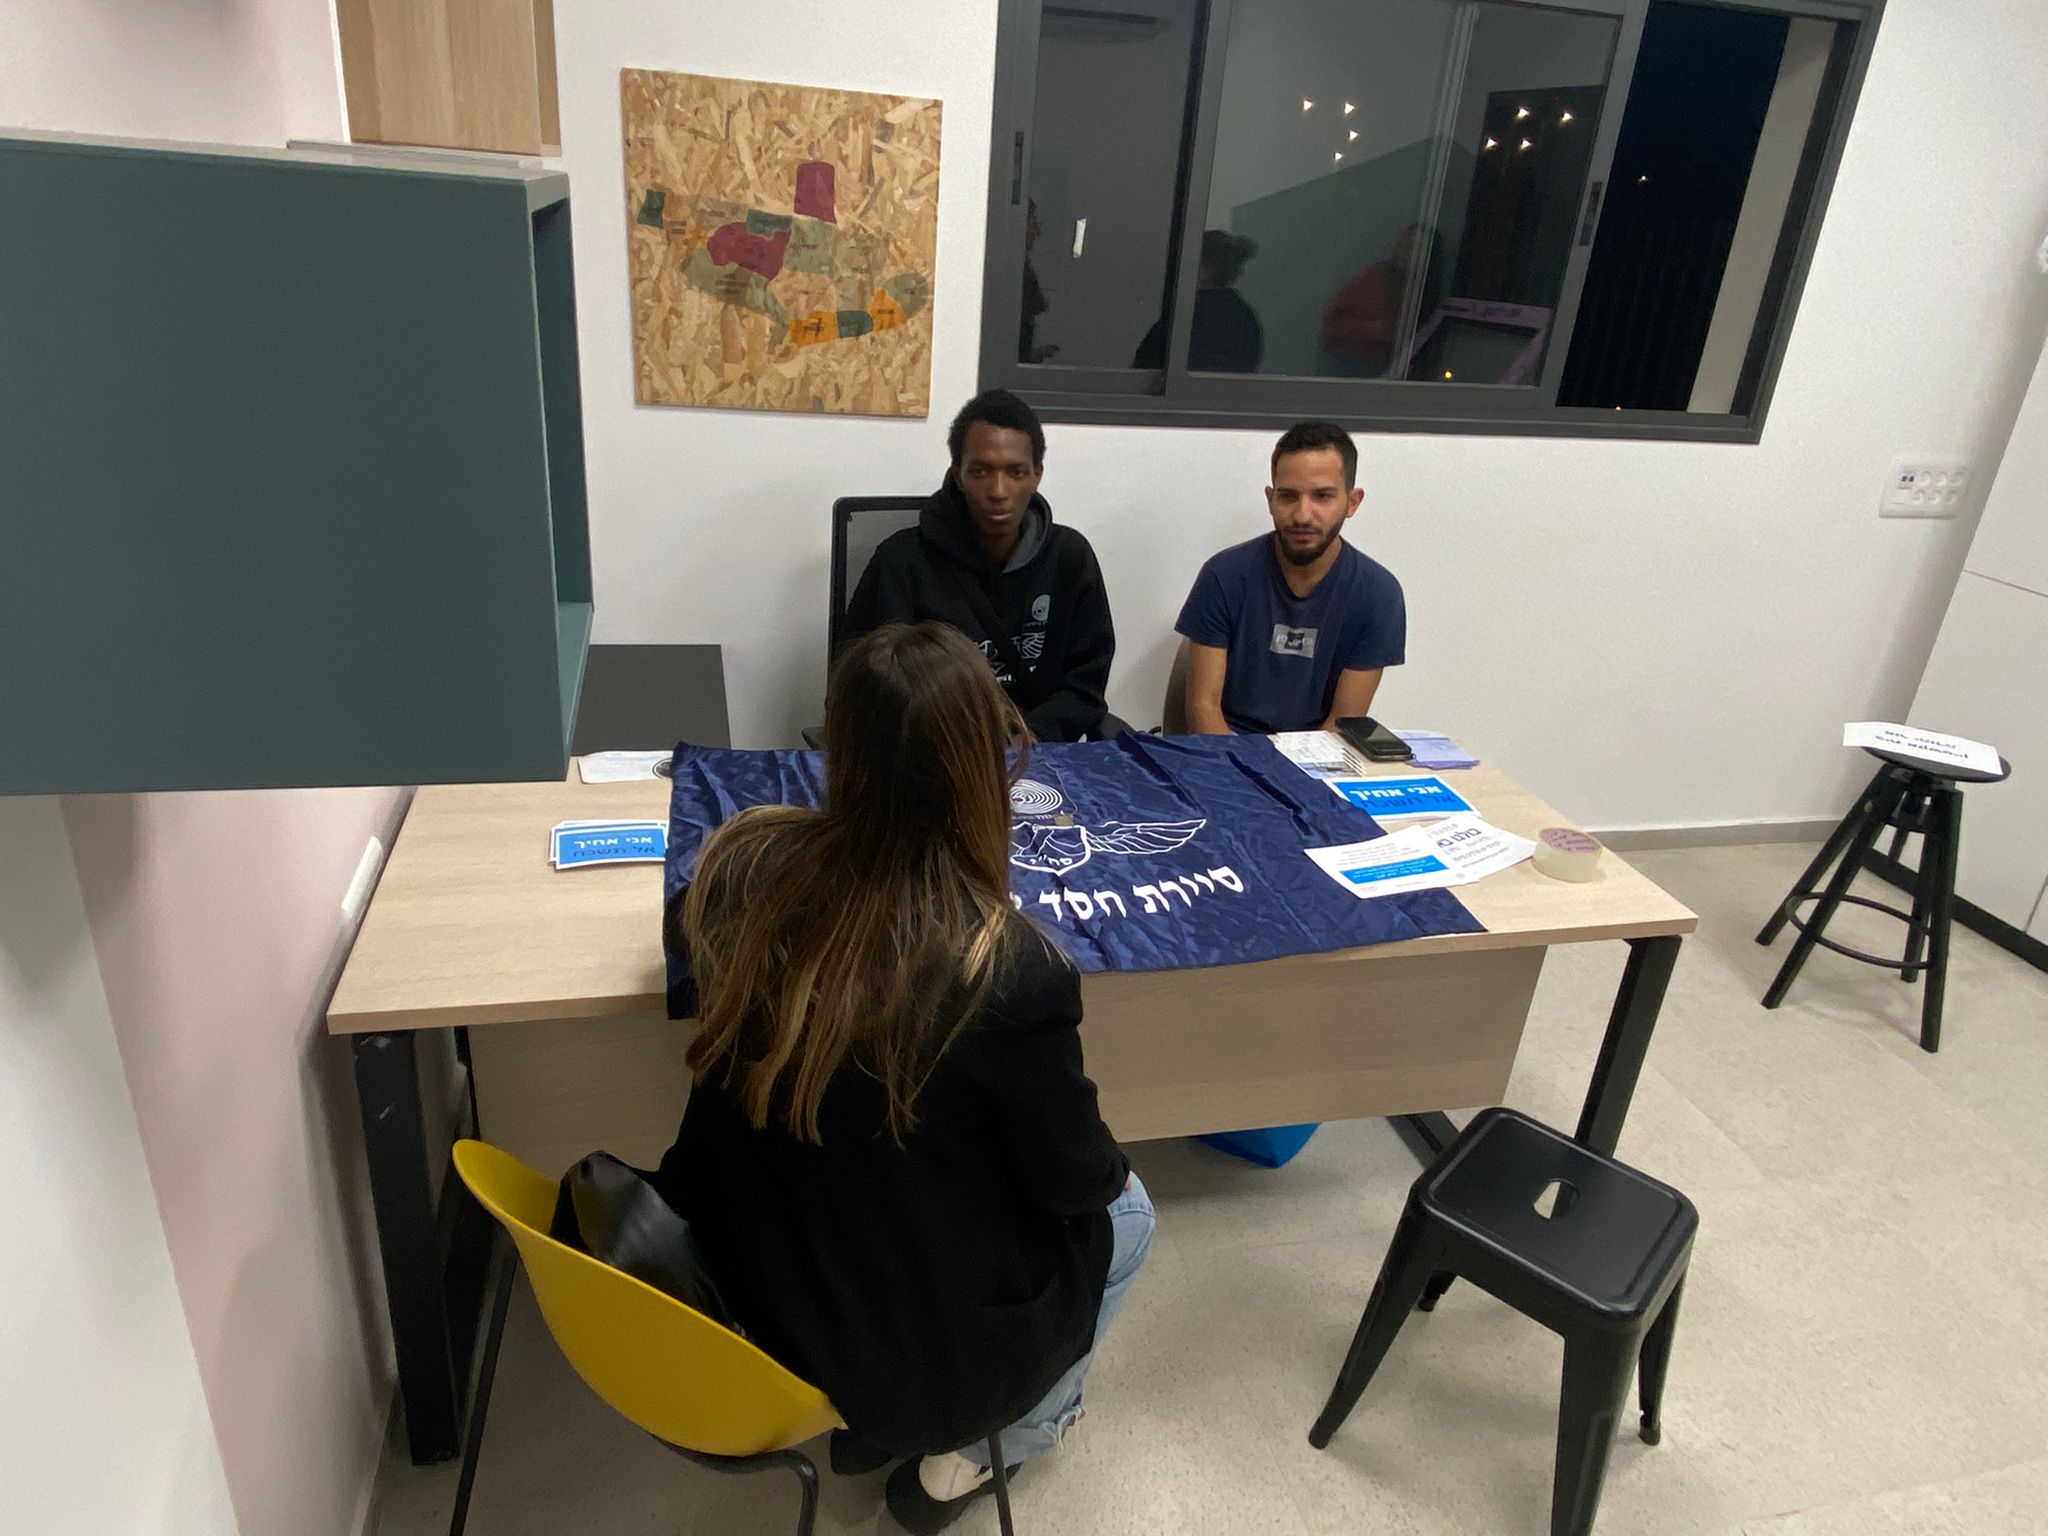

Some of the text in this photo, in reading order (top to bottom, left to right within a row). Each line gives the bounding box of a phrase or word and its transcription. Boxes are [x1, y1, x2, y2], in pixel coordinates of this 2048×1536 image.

[1349, 788, 1405, 801] אחיך
[1406, 785, 1443, 795] אני
[573, 836, 653, 849] אני אחיך
[573, 844, 656, 857] אל תשכח
[1132, 865, 1244, 914] סיירת
[1038, 886, 1127, 922] חסד
